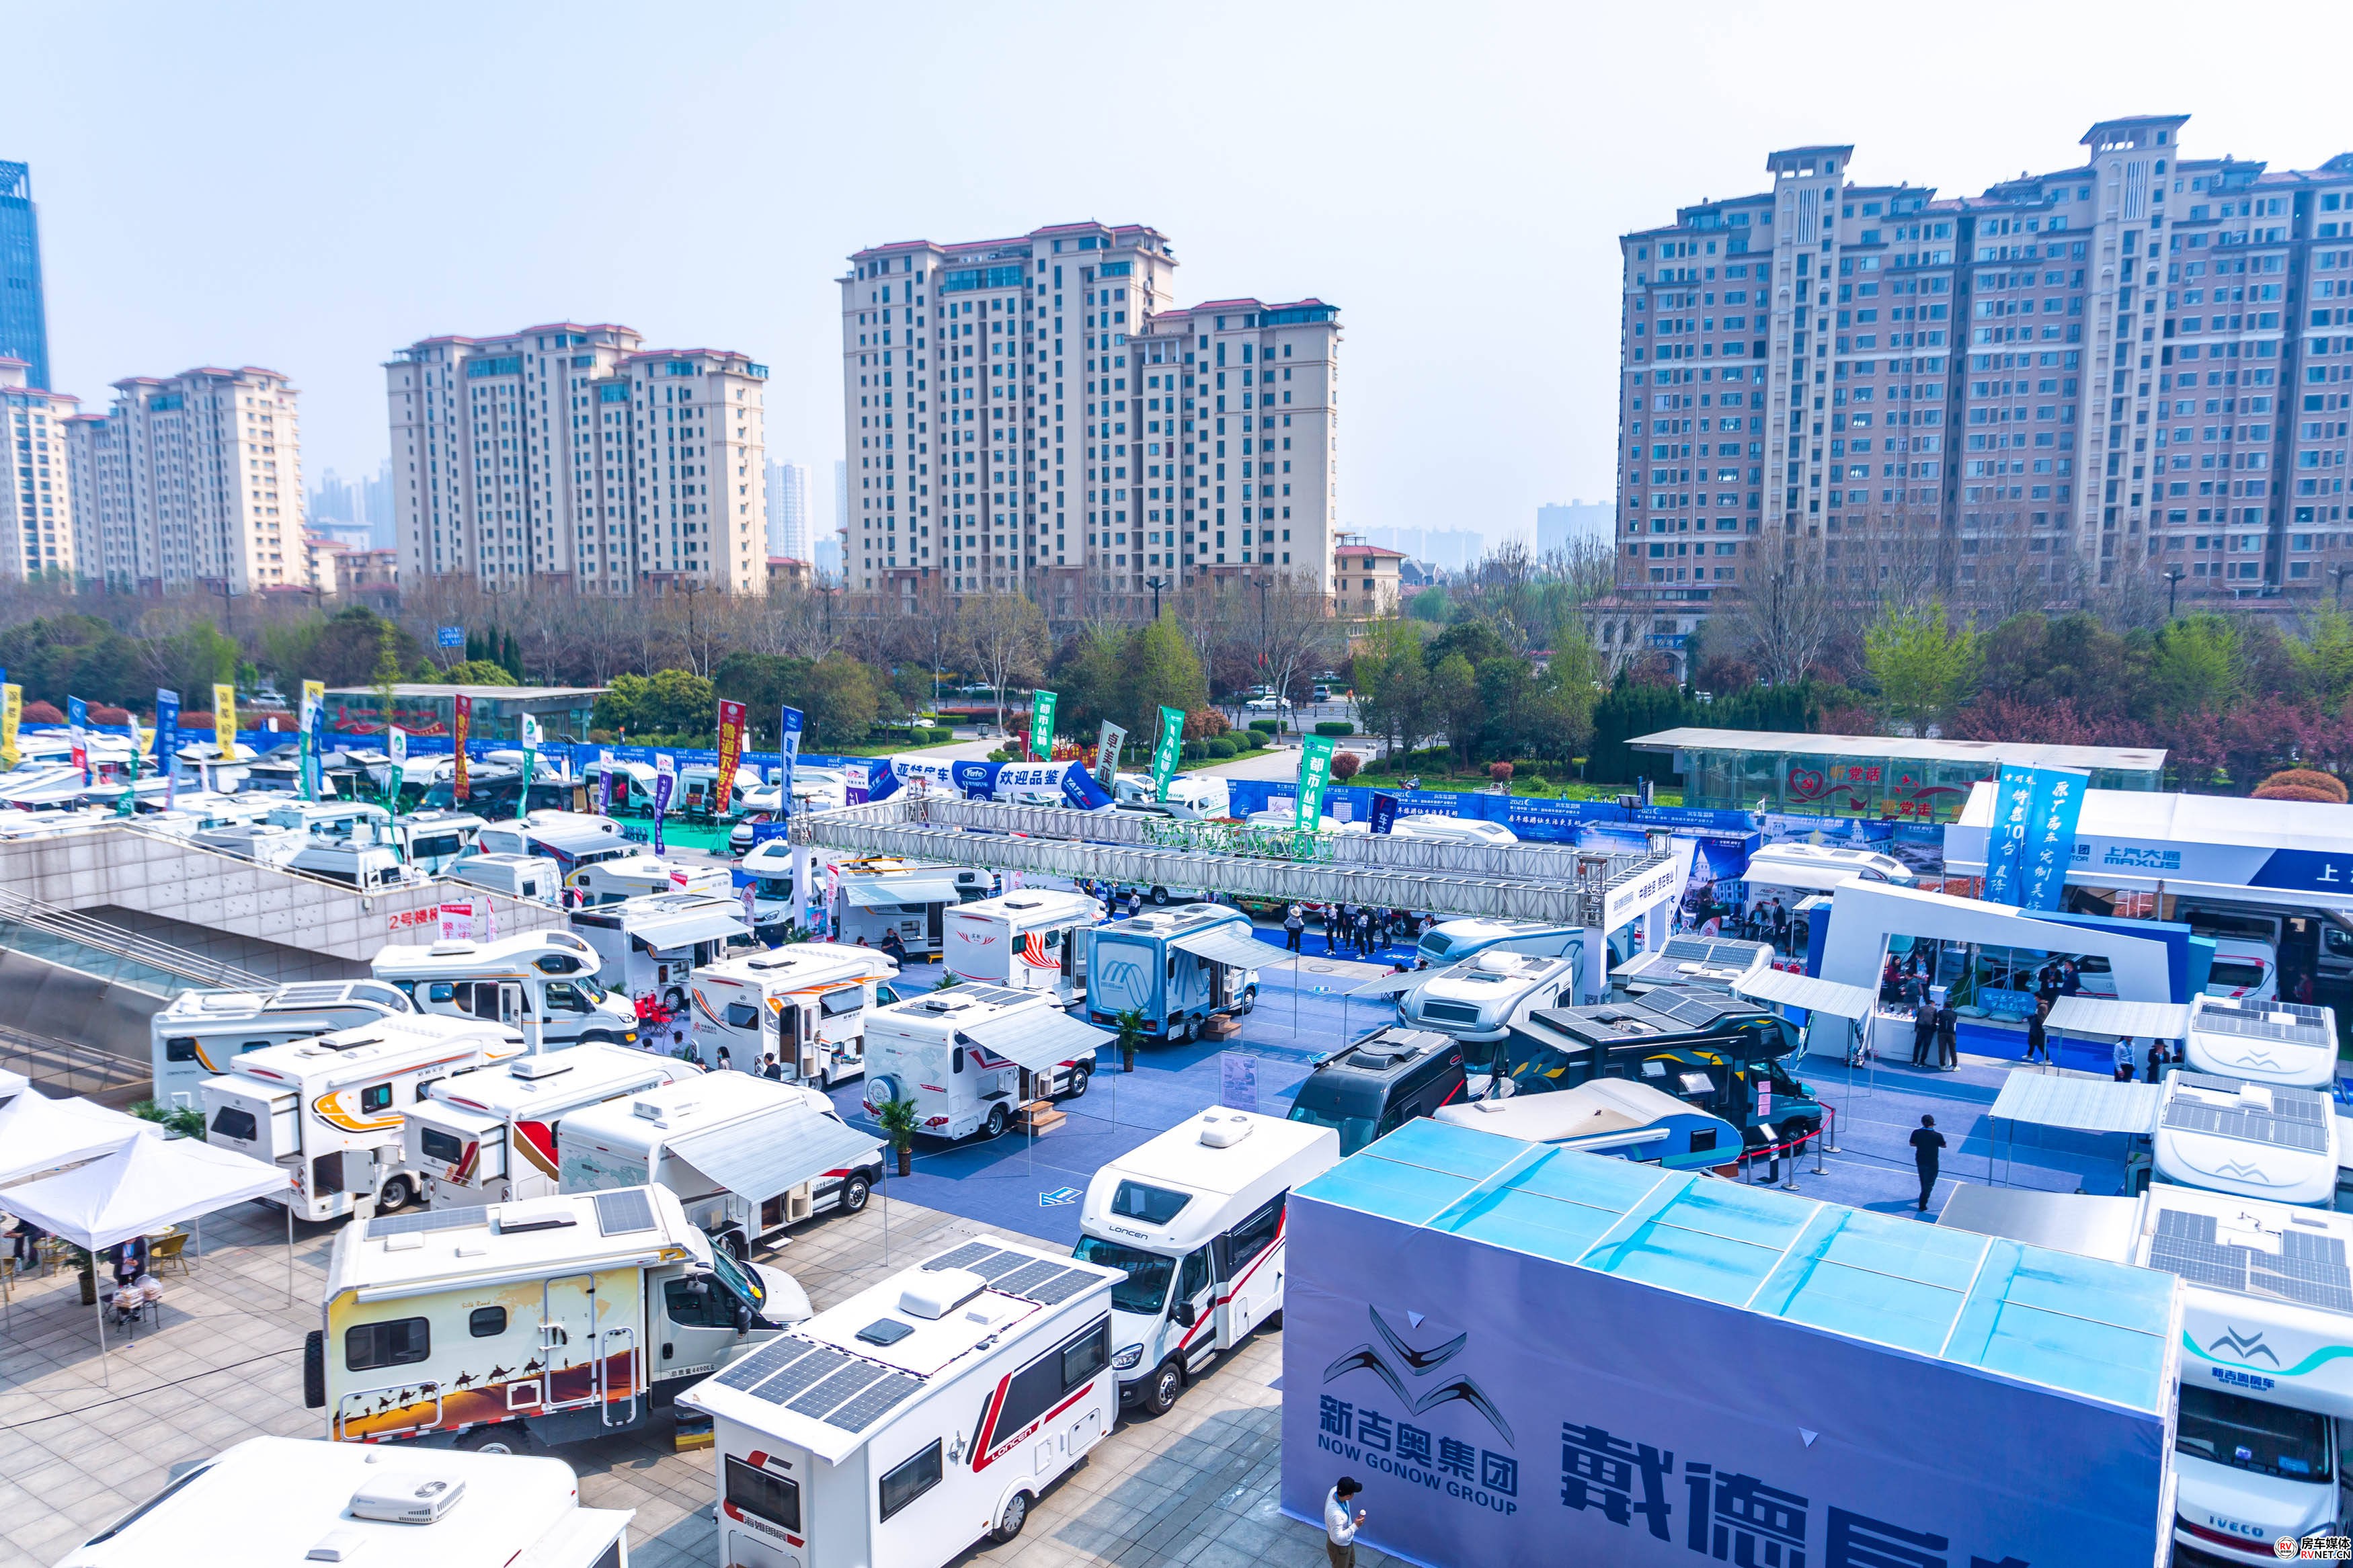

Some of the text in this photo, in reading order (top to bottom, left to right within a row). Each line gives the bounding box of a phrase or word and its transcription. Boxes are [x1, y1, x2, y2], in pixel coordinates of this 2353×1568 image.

[966, 768, 984, 778] Yate
[1000, 770, 1060, 785] 欢迎品鉴
[1830, 766, 1881, 782] 听党话
[1065, 776, 1084, 796] YATE
[2026, 781, 2069, 910] 原厂房车定制美好
[2104, 846, 2181, 862] 上汽大通
[2104, 856, 2180, 870] MAXUS
[1109, 1225, 1149, 1240] LONCEN
[2212, 1367, 2275, 1389] 新吉奥房车
[992, 1428, 1032, 1460] LONCEN
[1320, 1394, 1518, 1497] 新吉奥集团
[1318, 1434, 1517, 1516] NOW GONOW GROUP
[1561, 1421, 2032, 1568] 戴德
[2209, 1515, 2264, 1538] IVECO
